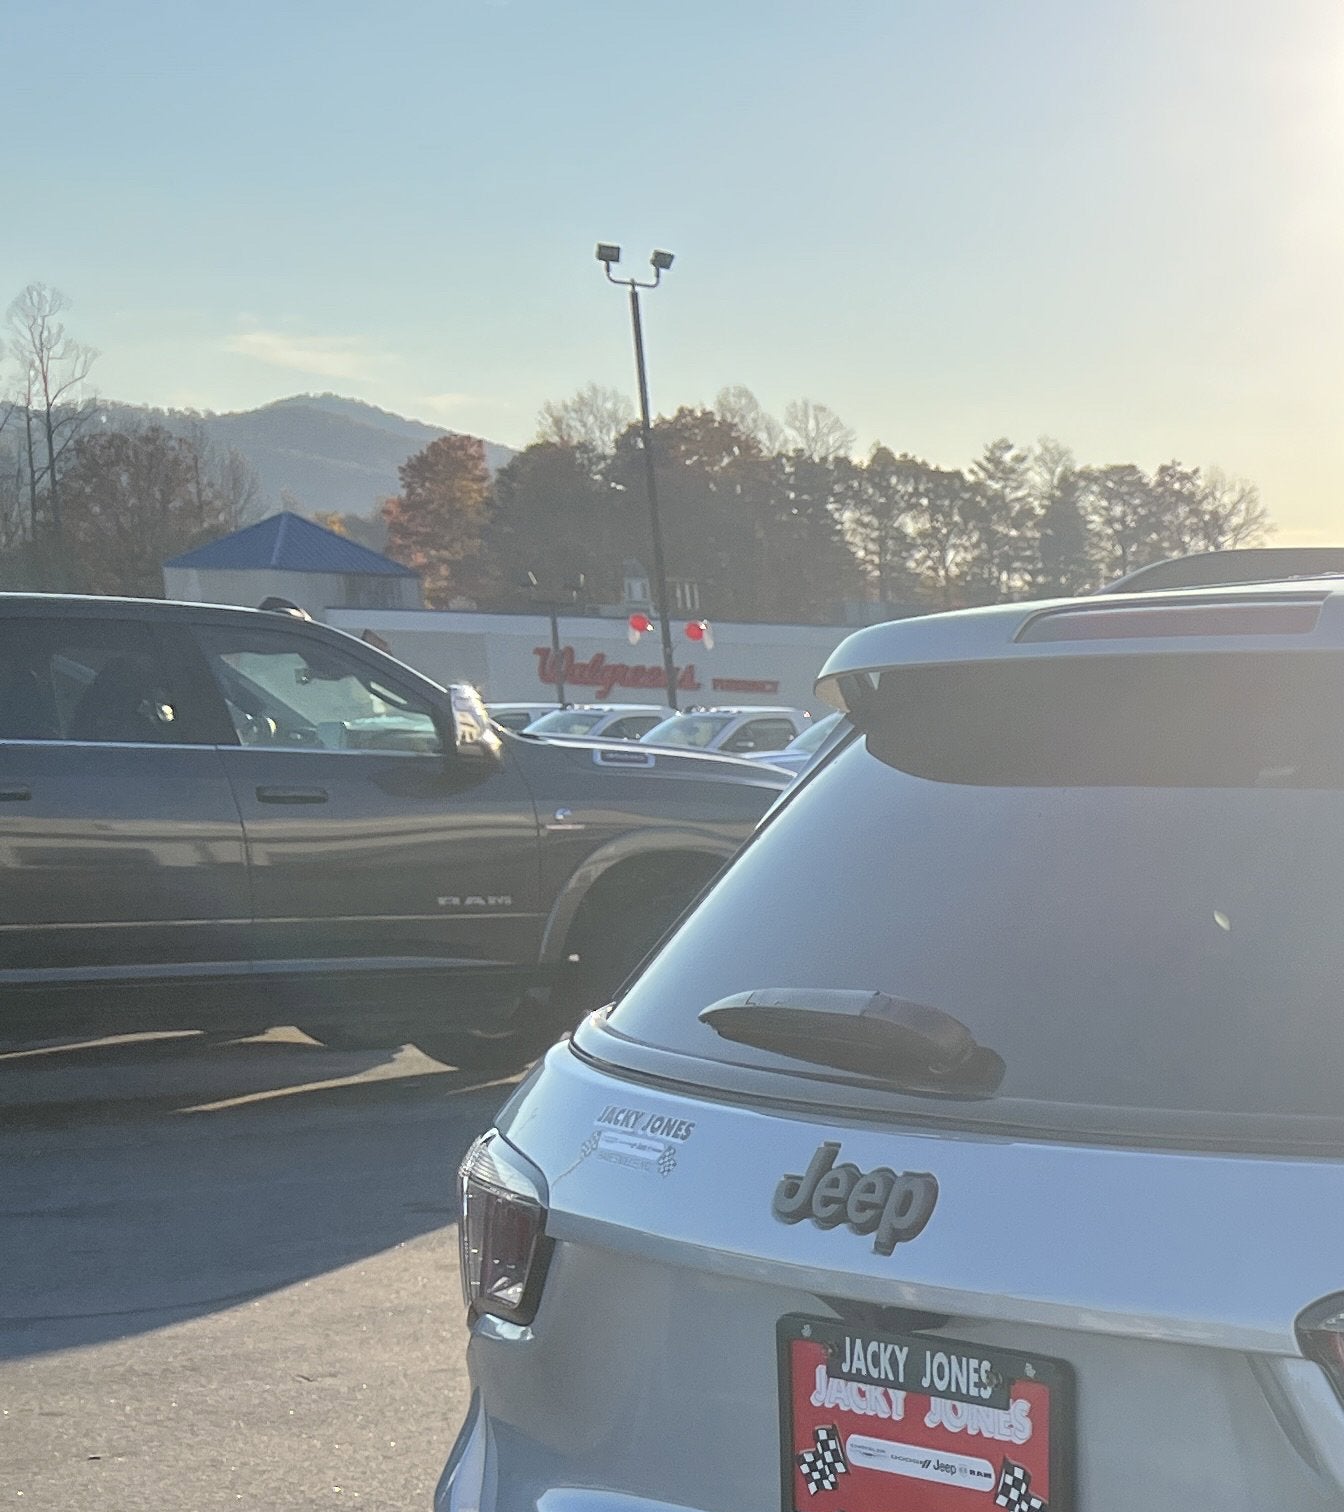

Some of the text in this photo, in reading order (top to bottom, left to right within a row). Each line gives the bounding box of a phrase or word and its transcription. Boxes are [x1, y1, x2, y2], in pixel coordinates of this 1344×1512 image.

[437, 896, 512, 906] RAM
[597, 1105, 696, 1141] JACKY JONES
[771, 1141, 940, 1257] Jeep
[841, 1336, 992, 1399] JACKY JONES
[932, 1459, 957, 1476] Jeep
[969, 1469, 992, 1479] RAM
